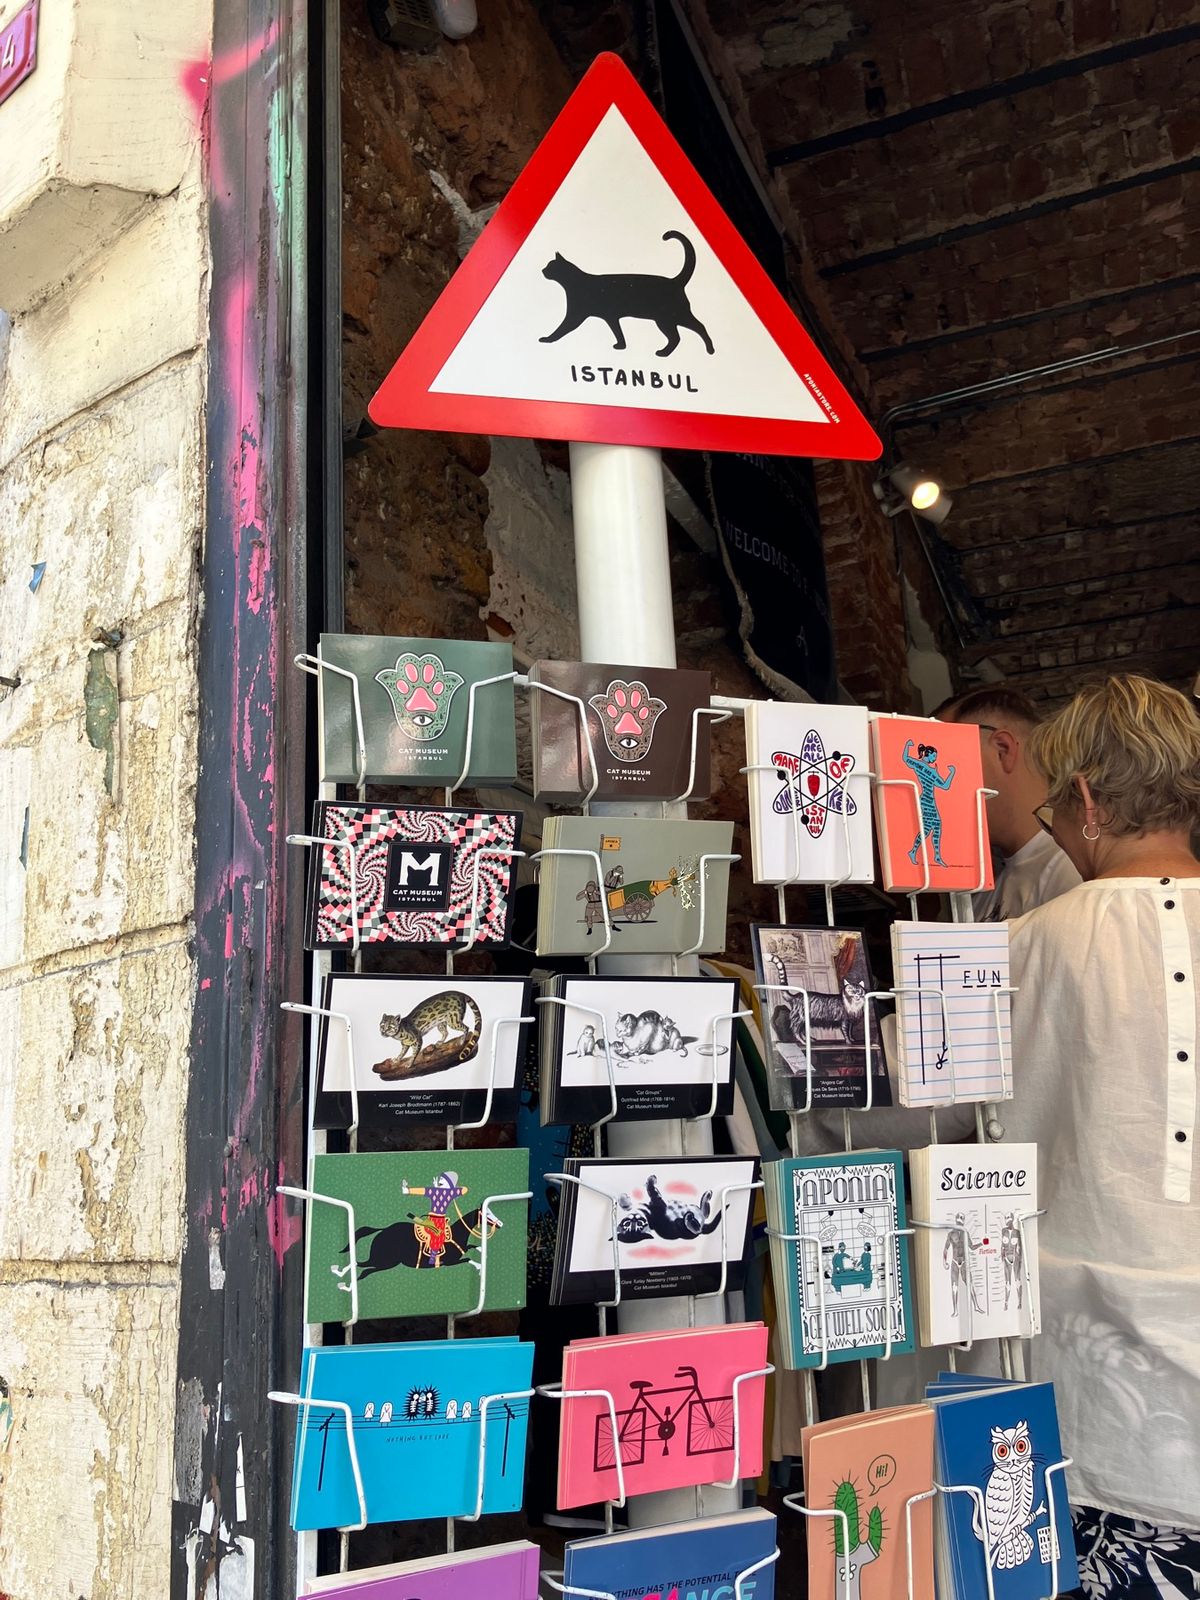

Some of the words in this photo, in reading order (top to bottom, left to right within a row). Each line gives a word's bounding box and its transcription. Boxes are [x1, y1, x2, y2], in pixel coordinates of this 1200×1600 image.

[571, 365, 698, 393] ISTANBUL
[803, 373, 841, 423] APONIASTORE.COM
[724, 518, 789, 576] WELCOME
[804, 743, 822, 753] ARE
[806, 733, 820, 744] WE
[774, 754, 799, 777] MADE
[829, 757, 851, 779] OF
[803, 753, 823, 763] ALL
[398, 852, 442, 886] M
[963, 970, 1001, 984] FUN
[802, 1174, 888, 1206] APONIA
[940, 1166, 1027, 1192] Science
[809, 1312, 830, 1340] GET
[832, 1308, 864, 1337] WELL
[865, 1305, 898, 1333] SOON
[875, 1463, 888, 1480] Hi!
[589, 1586, 645, 1600] YTHING
[646, 1583, 665, 1594] HAS
[667, 1580, 684, 1591] THE
[685, 1573, 732, 1587] POTENTIAL
